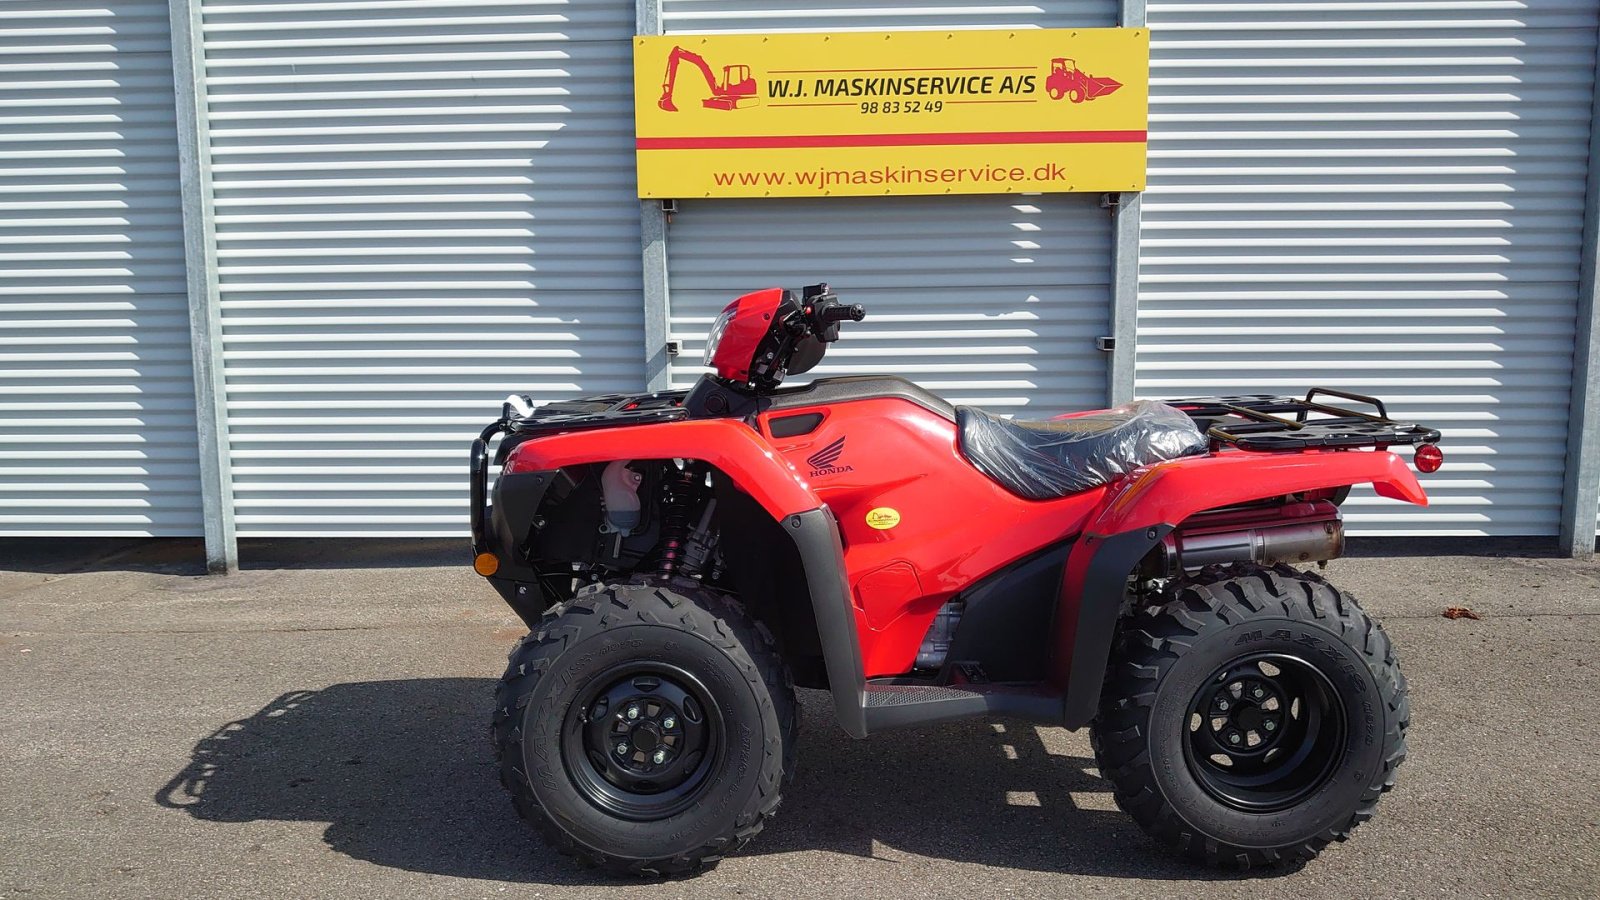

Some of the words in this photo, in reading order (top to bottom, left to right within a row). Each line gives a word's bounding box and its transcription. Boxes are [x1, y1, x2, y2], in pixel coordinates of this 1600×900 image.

[768, 79, 807, 98] W.J.
[814, 76, 994, 96] MASKINSERVICE
[998, 75, 1036, 94] A/S
[860, 101, 879, 114] 98
[882, 101, 900, 114] 83
[903, 101, 921, 113] 52
[924, 100, 943, 113] 49
[713, 162, 1066, 189] www.wjmaskinservice.dk
[809, 465, 854, 477] HONDA
[1233, 628, 1367, 694] MAXXIS
